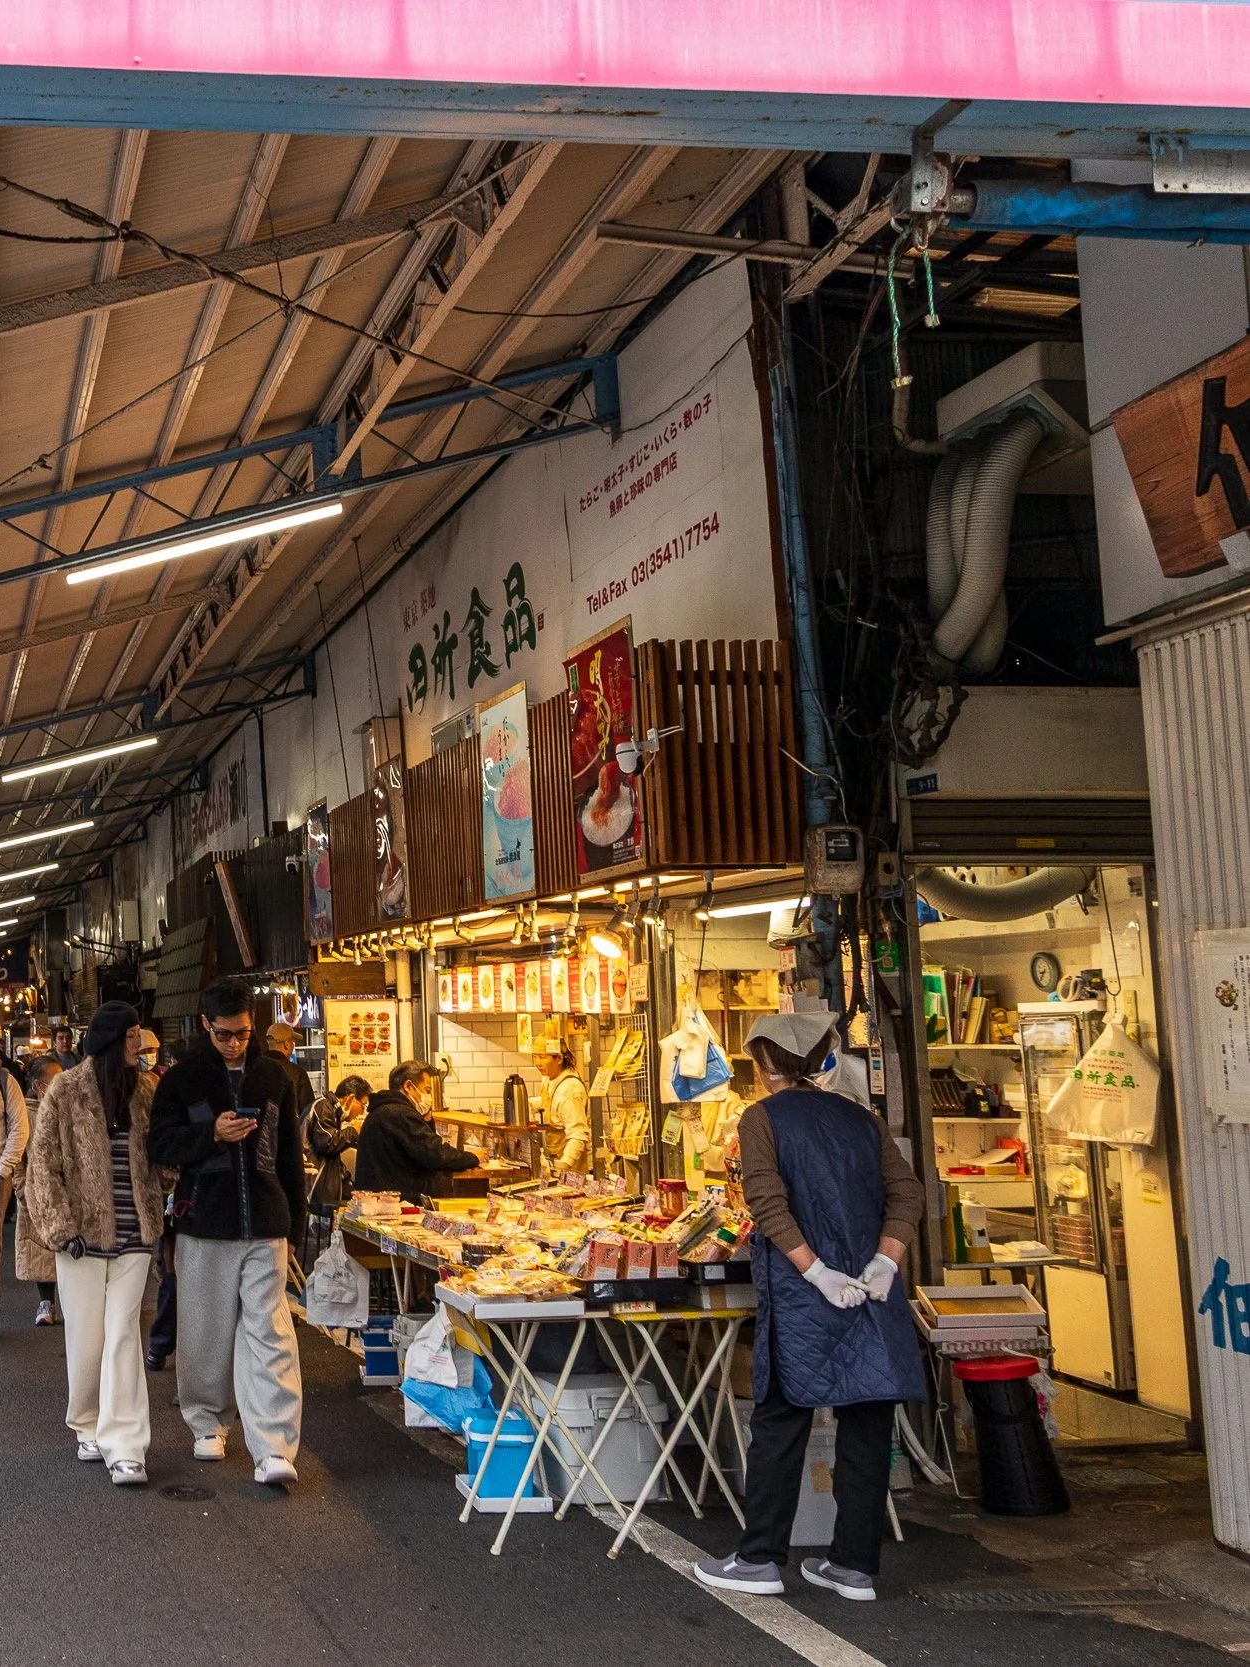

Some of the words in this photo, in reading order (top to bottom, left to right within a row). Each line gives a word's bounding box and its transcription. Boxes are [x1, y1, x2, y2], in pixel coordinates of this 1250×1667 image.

[609, 451, 678, 519] 魚卵と珍味の専門店
[586, 577, 628, 615] Tel&Fax
[631, 511, 720, 587] 03(3541)7754
